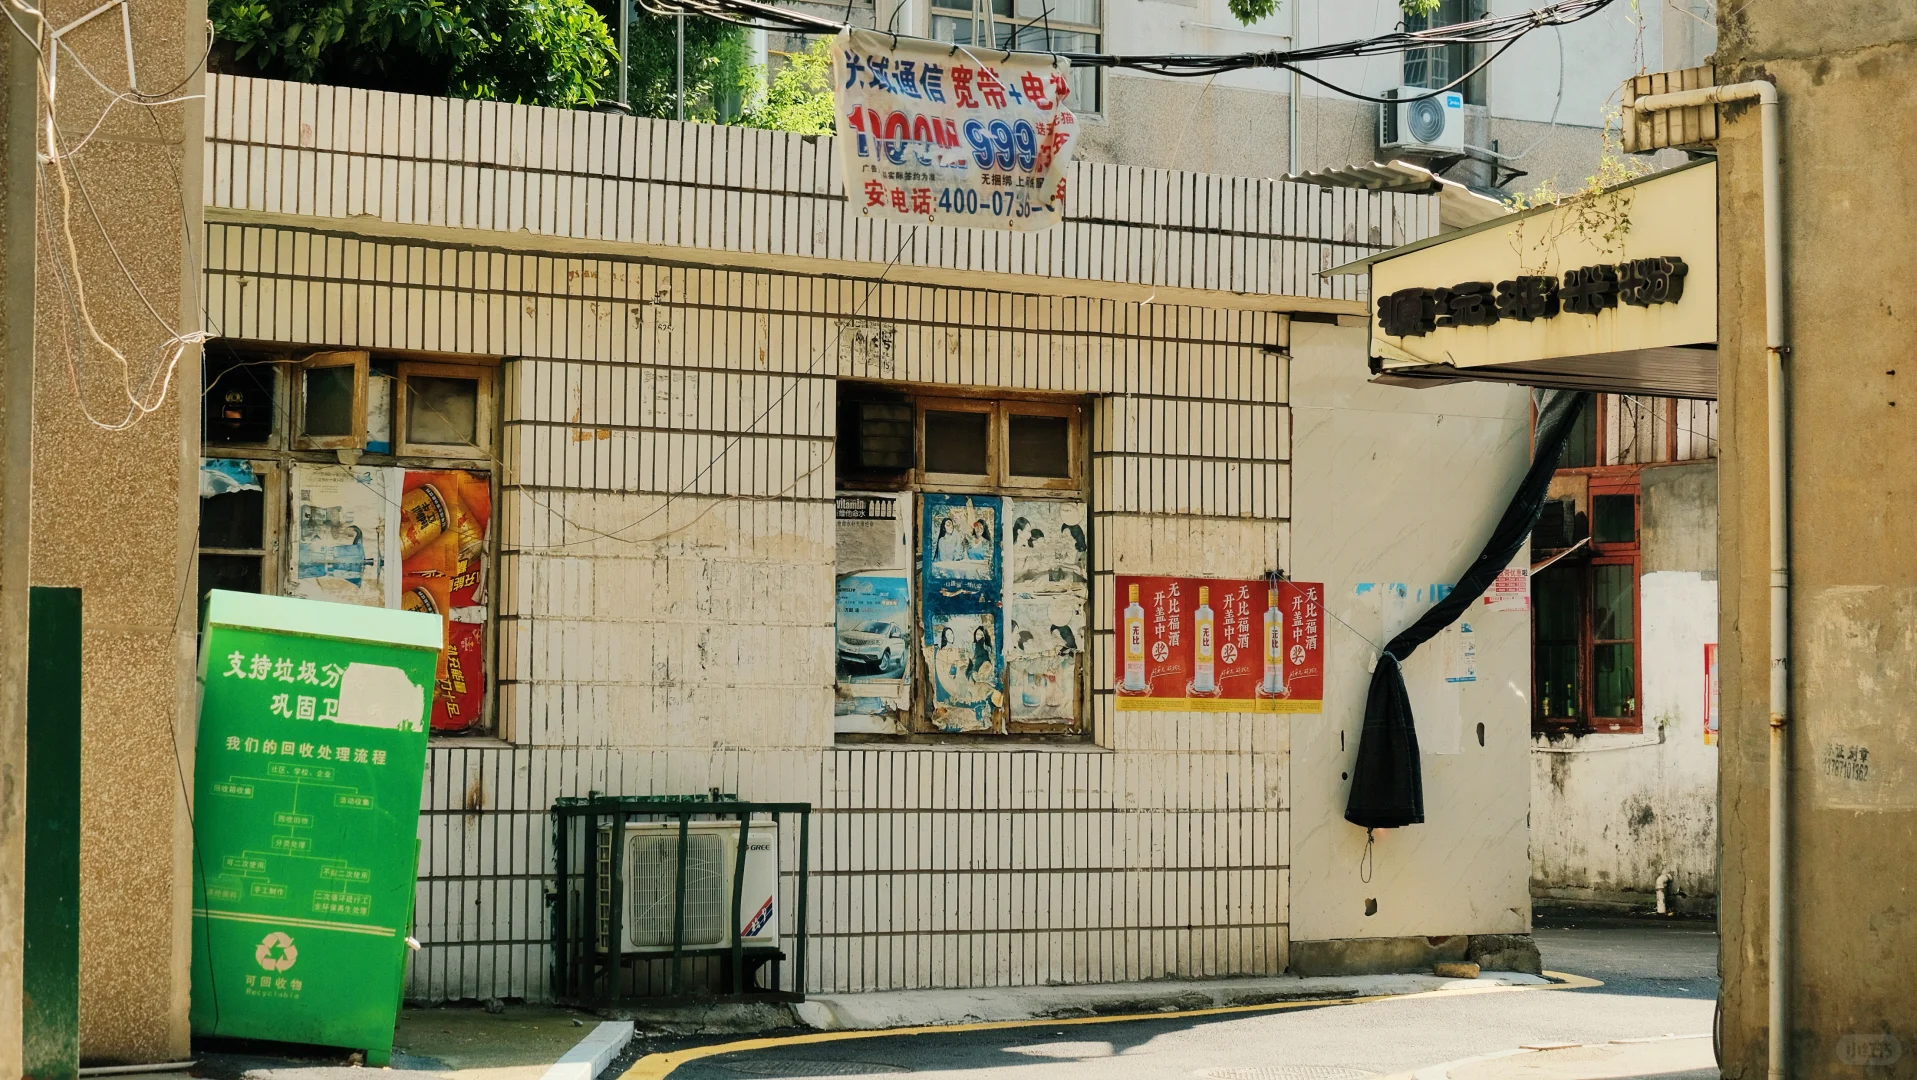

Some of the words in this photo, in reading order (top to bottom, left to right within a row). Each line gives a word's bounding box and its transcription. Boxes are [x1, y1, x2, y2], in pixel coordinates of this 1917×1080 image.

[963, 118, 1038, 172] 999
[1167, 582, 1181, 647] 无比福酒
[1237, 585, 1250, 649] 无比福酒
[1304, 587, 1318, 650] 无比福酒
[226, 736, 387, 766] 我们的回收处理流程
[245, 974, 303, 991] 可回收物
[245, 987, 300, 999] Recyclable
